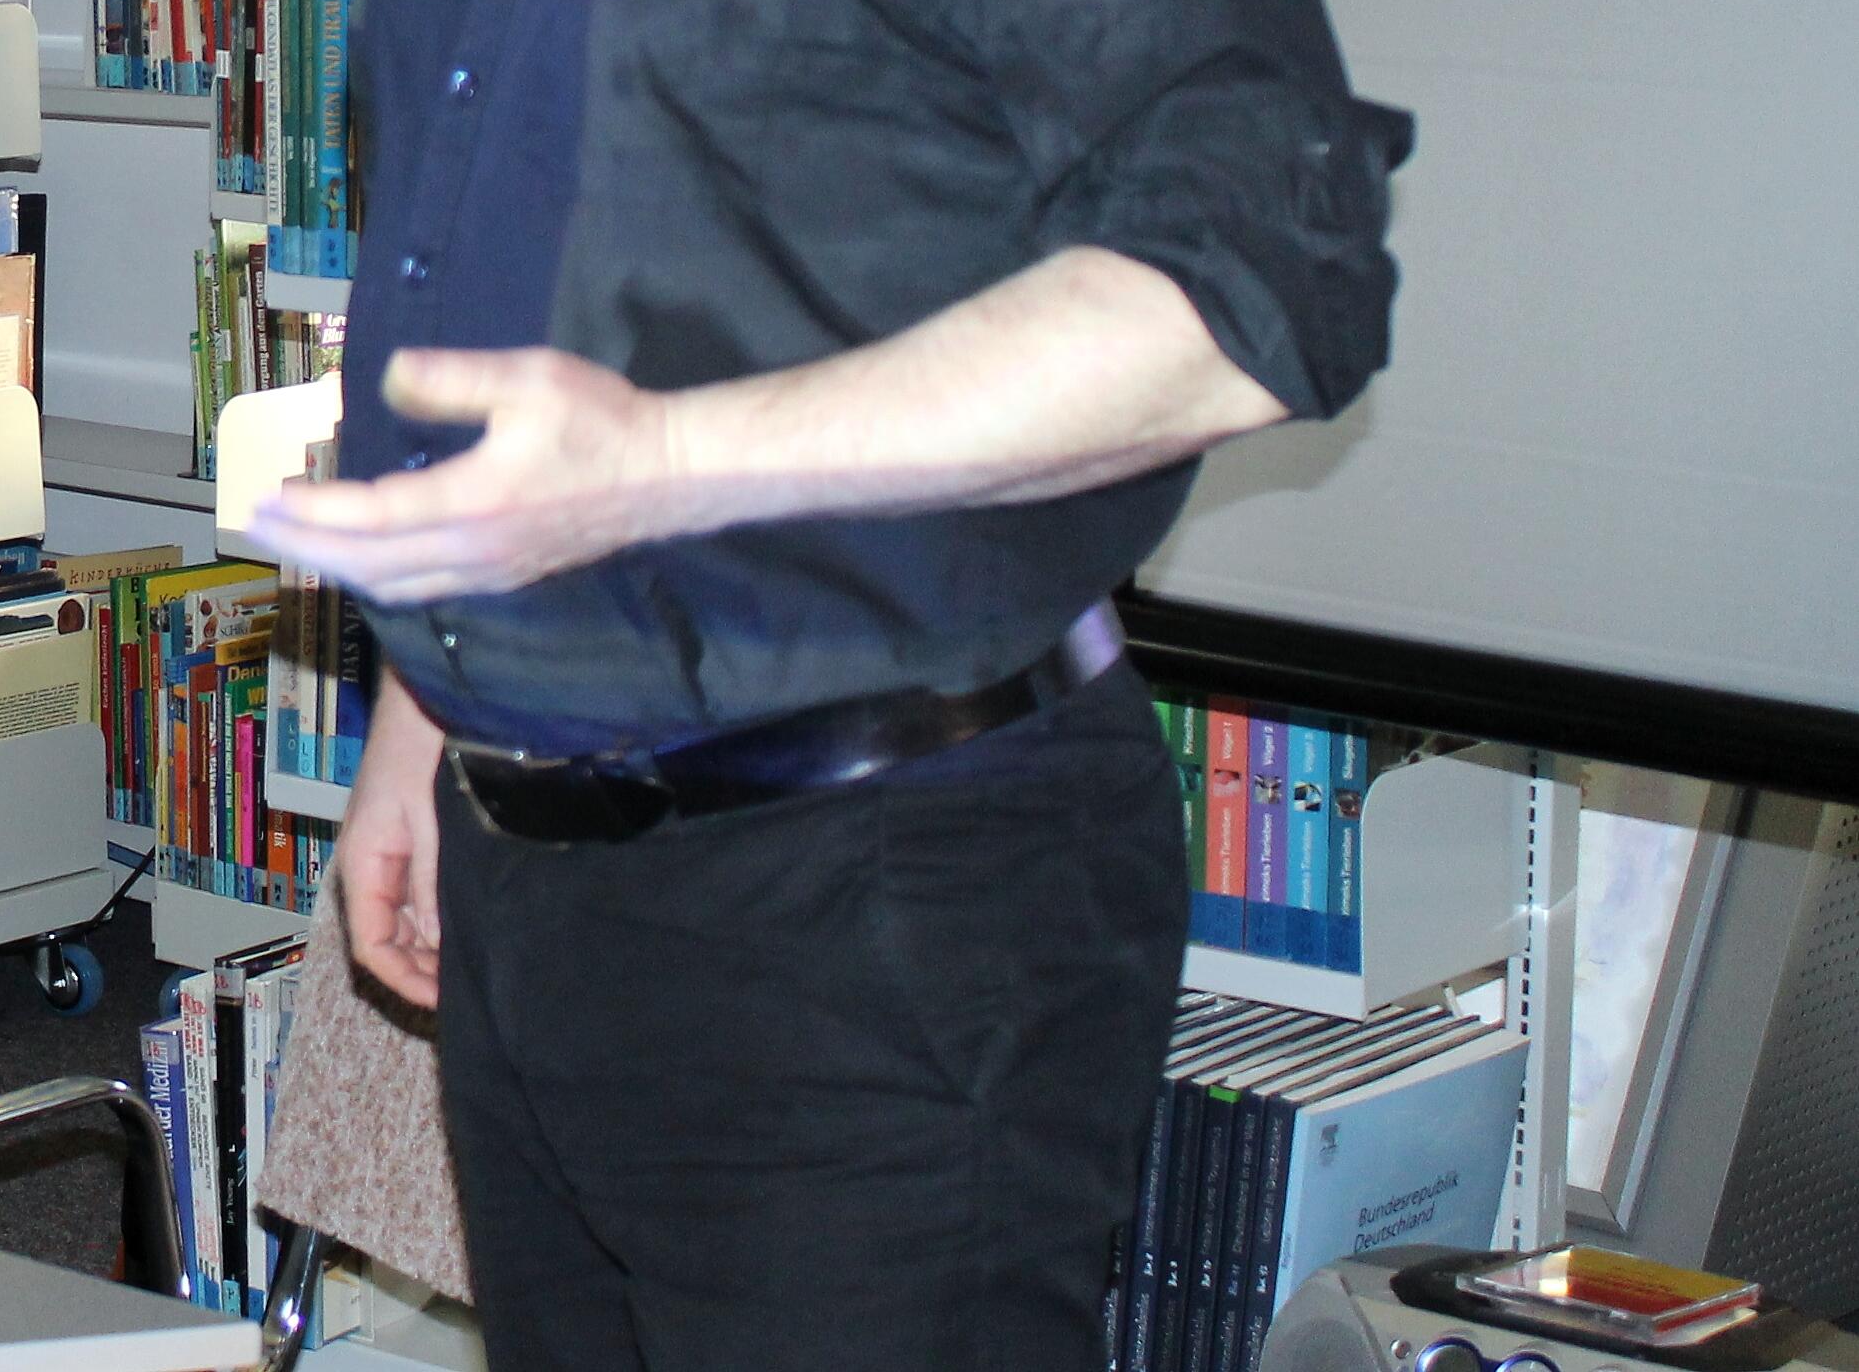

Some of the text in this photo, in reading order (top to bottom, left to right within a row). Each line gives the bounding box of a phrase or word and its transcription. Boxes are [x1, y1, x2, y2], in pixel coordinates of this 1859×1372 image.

[323, 46, 342, 86] UND
[268, 95, 280, 125] DER
[323, 93, 342, 148] TATEN
[269, 126, 280, 215] GESCHICHTE
[255, 271, 265, 307] Garten
[259, 333, 268, 351] aus
[1223, 732, 1233, 759] Vögel
[1263, 735, 1274, 766] Vögel
[1220, 808, 1231, 856] Tierleben
[1262, 813, 1273, 862] Tierleben
[1342, 827, 1352, 877] Tierleben
[146, 1041, 171, 1102] Medizin
[186, 1054, 194, 1079] BAND
[188, 1096, 197, 1148] ENTDECKER
[1359, 1170, 1459, 1228] Bundesrepublik
[1354, 1200, 1436, 1253] Deutschland
